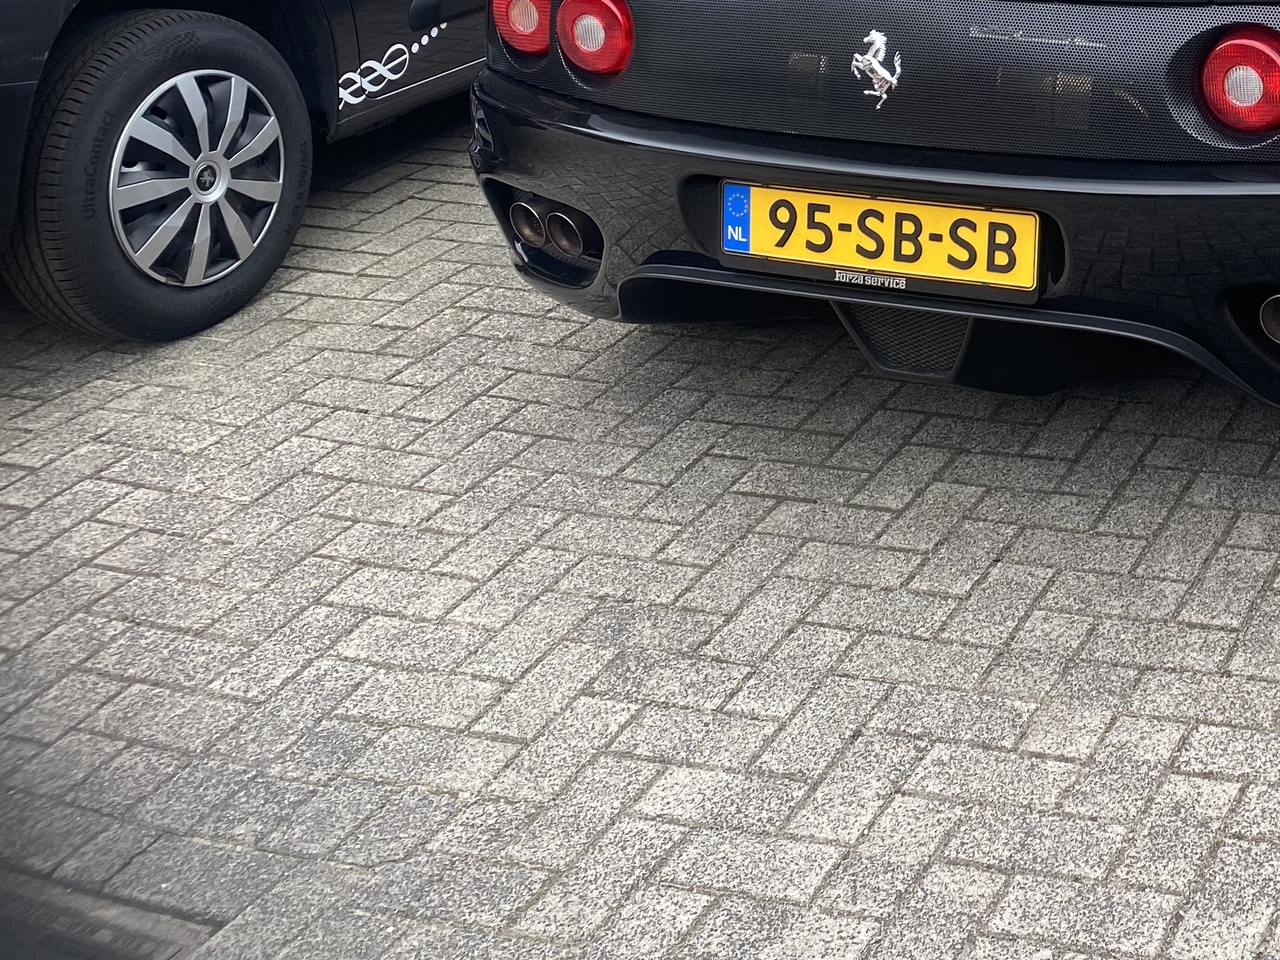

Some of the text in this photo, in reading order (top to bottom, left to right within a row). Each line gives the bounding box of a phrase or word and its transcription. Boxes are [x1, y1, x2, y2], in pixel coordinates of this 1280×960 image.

[727, 224, 747, 242] NL
[768, 198, 1018, 275] 95-SB-SB
[834, 269, 908, 290] Forza service
